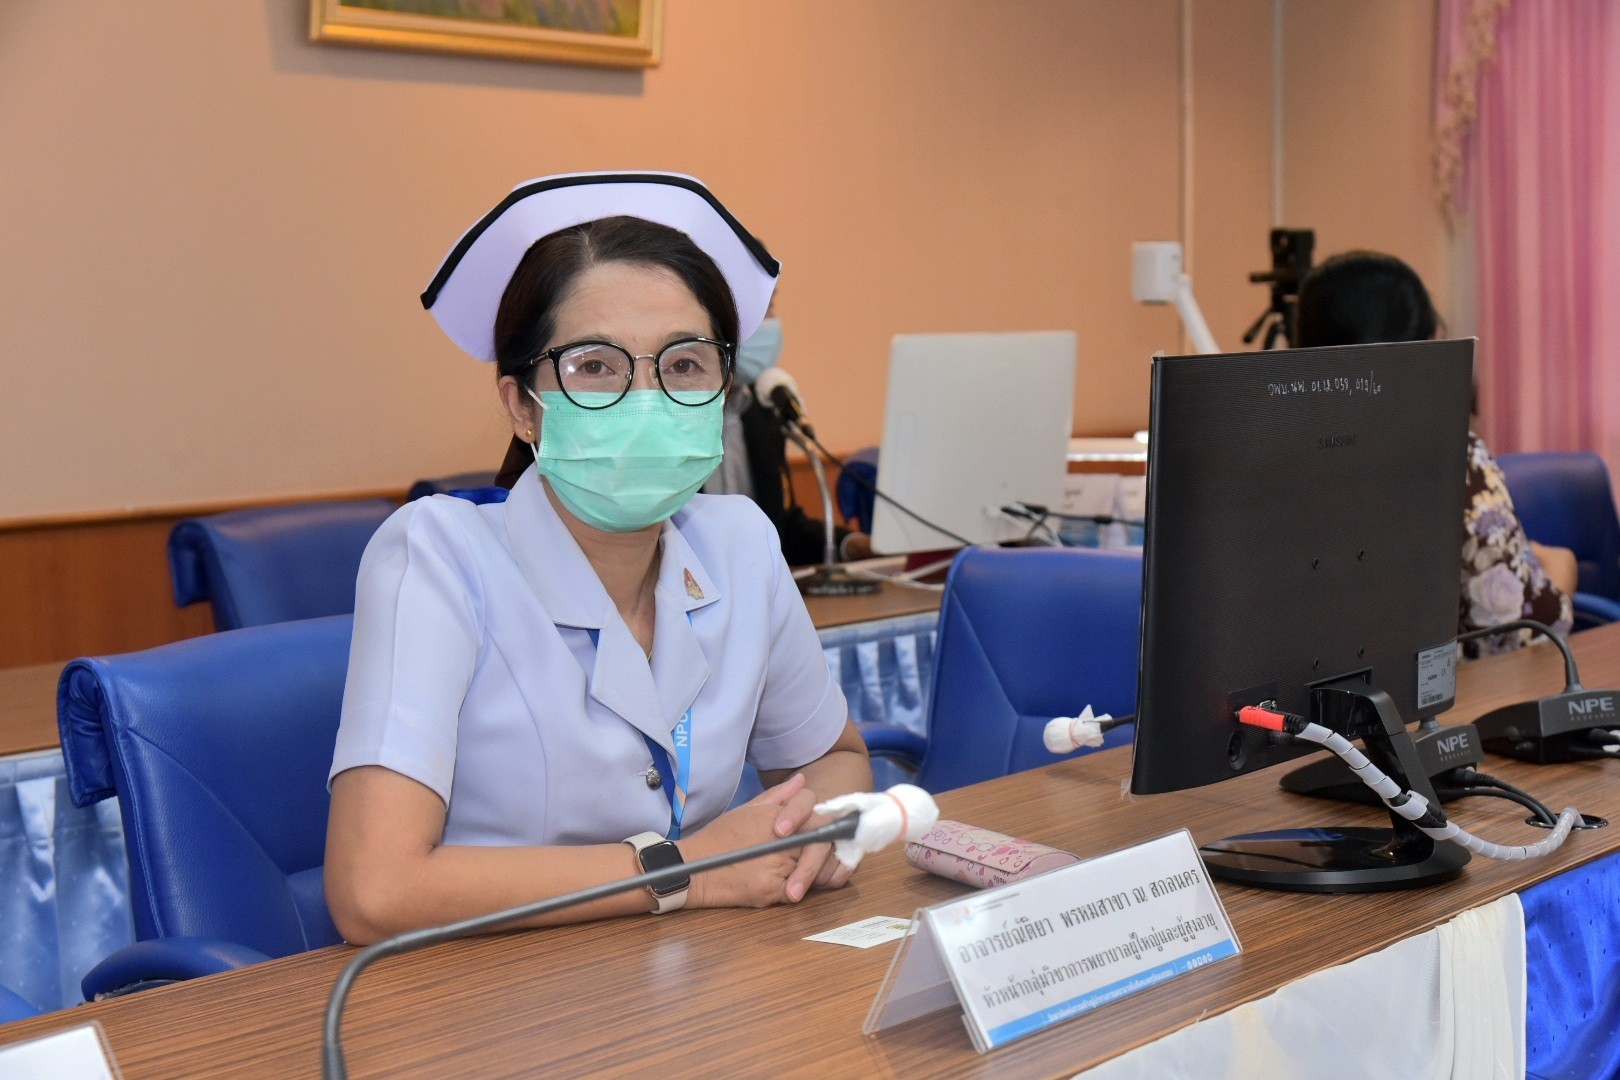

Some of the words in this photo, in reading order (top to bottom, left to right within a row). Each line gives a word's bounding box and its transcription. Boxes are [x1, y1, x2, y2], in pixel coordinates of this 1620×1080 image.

[1568, 697, 1614, 715] NPE
[1436, 733, 1469, 755] NPE
[1059, 891, 1131, 928] พรหมสาขา
[1149, 869, 1200, 898] สกลนคร
